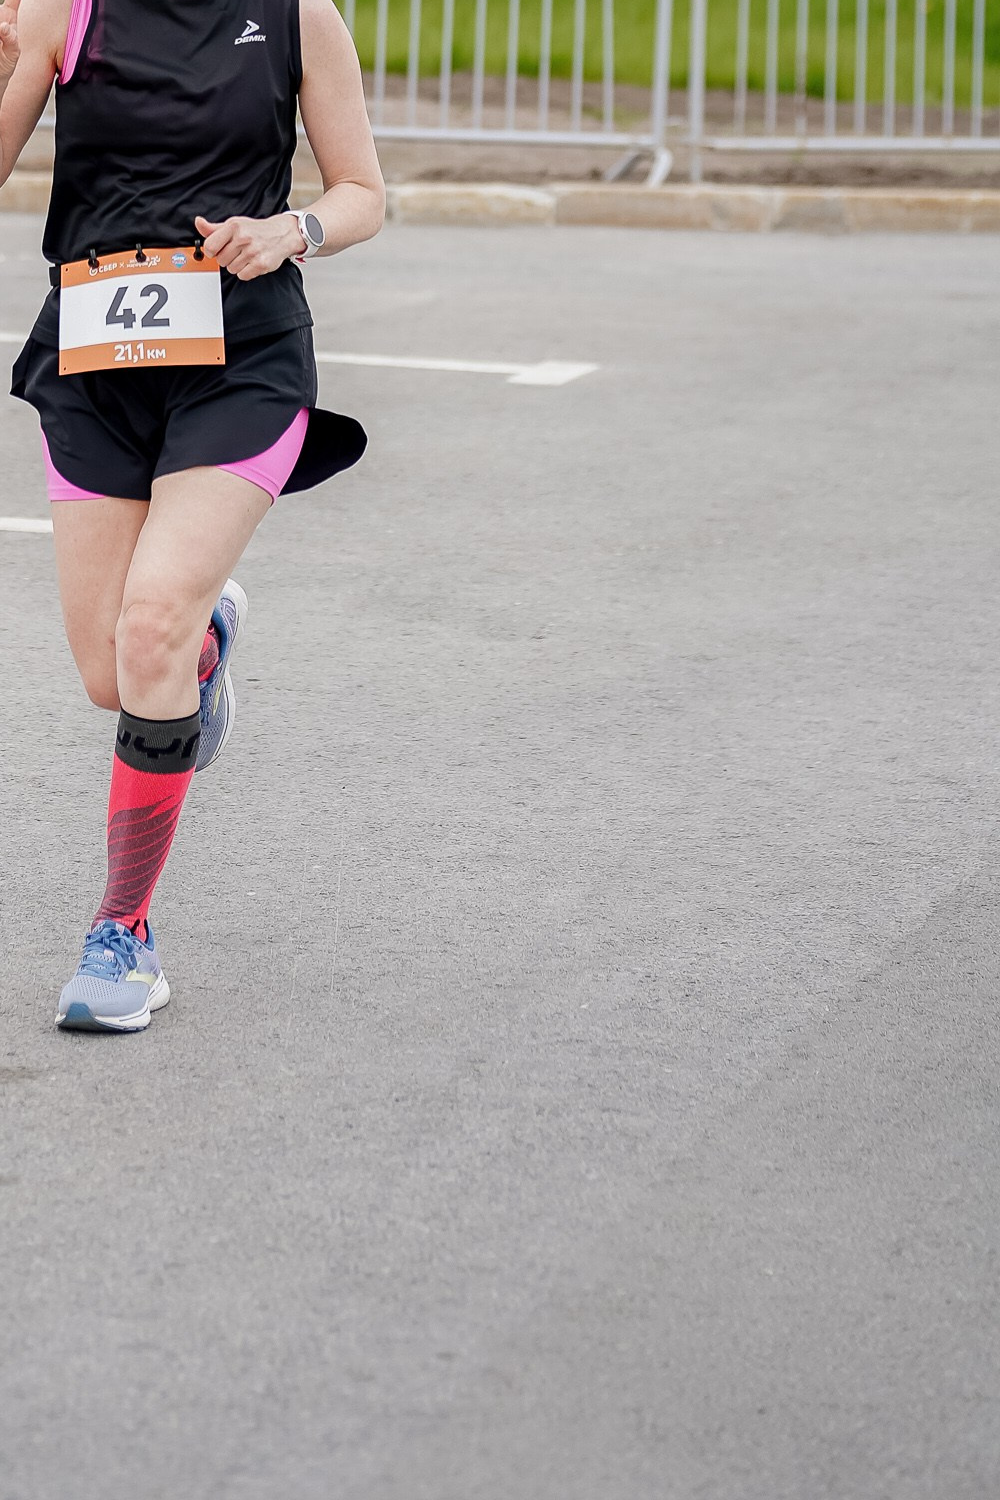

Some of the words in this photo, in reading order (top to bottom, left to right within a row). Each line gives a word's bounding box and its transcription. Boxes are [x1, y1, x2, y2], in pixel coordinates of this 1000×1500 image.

[234, 35, 266, 45] DEMIX
[99, 263, 118, 273] СБЕР
[106, 284, 170, 329] 42
[114, 342, 144, 363] 21,1
